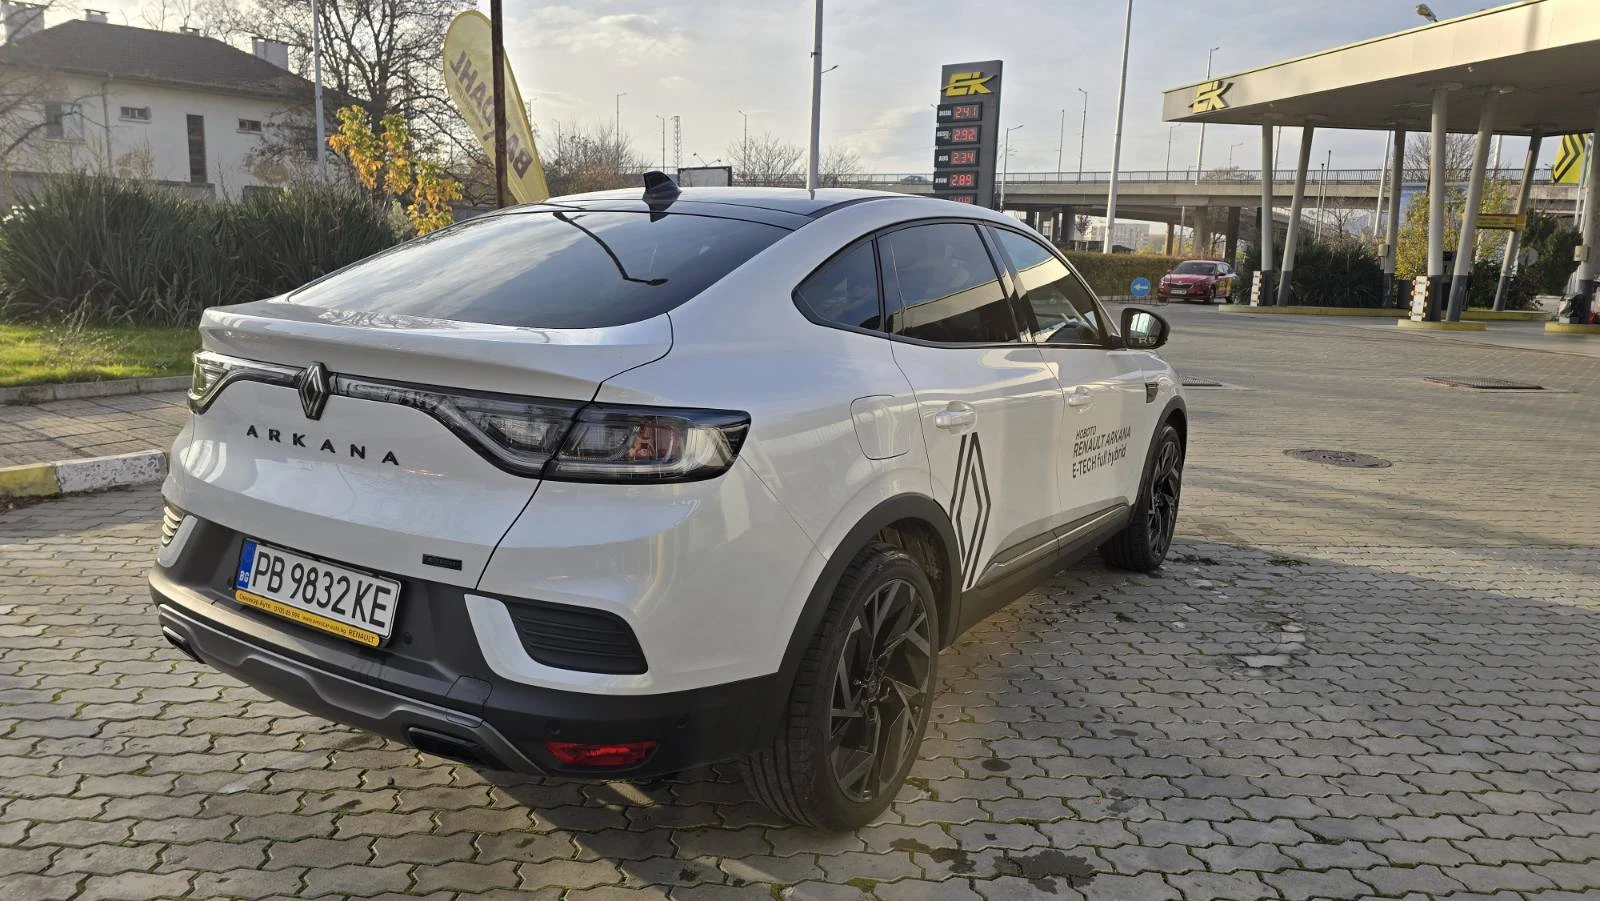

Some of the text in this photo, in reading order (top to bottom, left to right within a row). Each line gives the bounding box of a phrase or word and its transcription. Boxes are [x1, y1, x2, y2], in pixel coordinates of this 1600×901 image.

[246, 424, 399, 466] ARKANA
[1073, 426, 1130, 458] RENAULT ARKANA
[1073, 443, 1128, 478] E-TECH full hybrid
[239, 570, 250, 583] BG
[252, 551, 391, 629] PB 9832 KE
[348, 628, 376, 644] RENAULT
